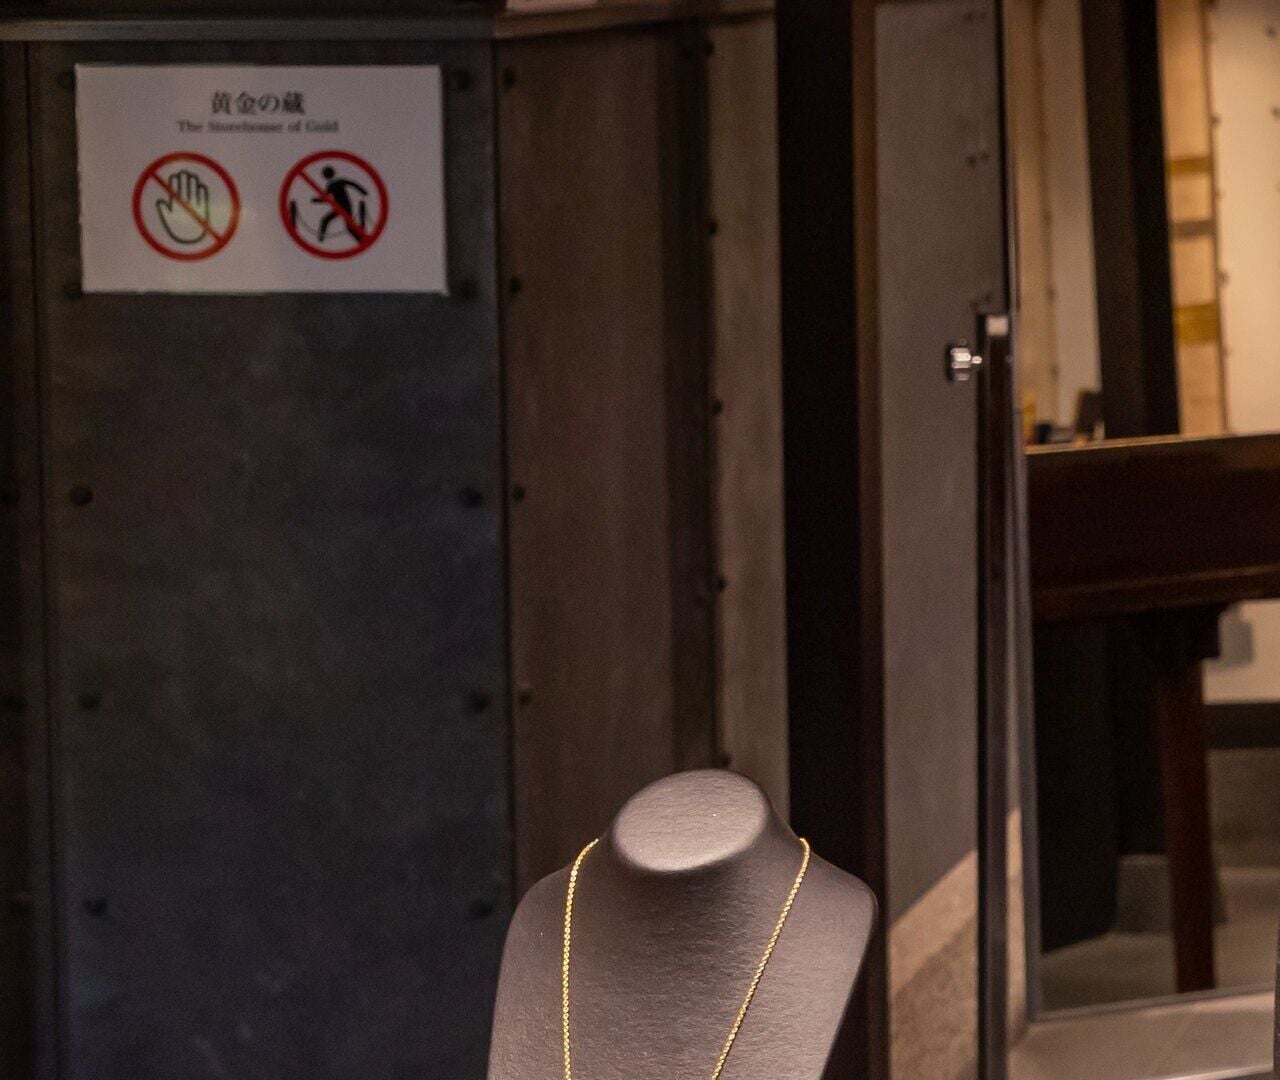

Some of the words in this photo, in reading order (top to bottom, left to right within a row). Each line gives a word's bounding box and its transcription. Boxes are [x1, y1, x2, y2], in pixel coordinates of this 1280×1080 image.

[211, 90, 305, 115] 黄金の蔵
[178, 119, 203, 132] The
[208, 120, 283, 132] Storehouse
[287, 119, 301, 132] of
[305, 119, 339, 132] Gold
